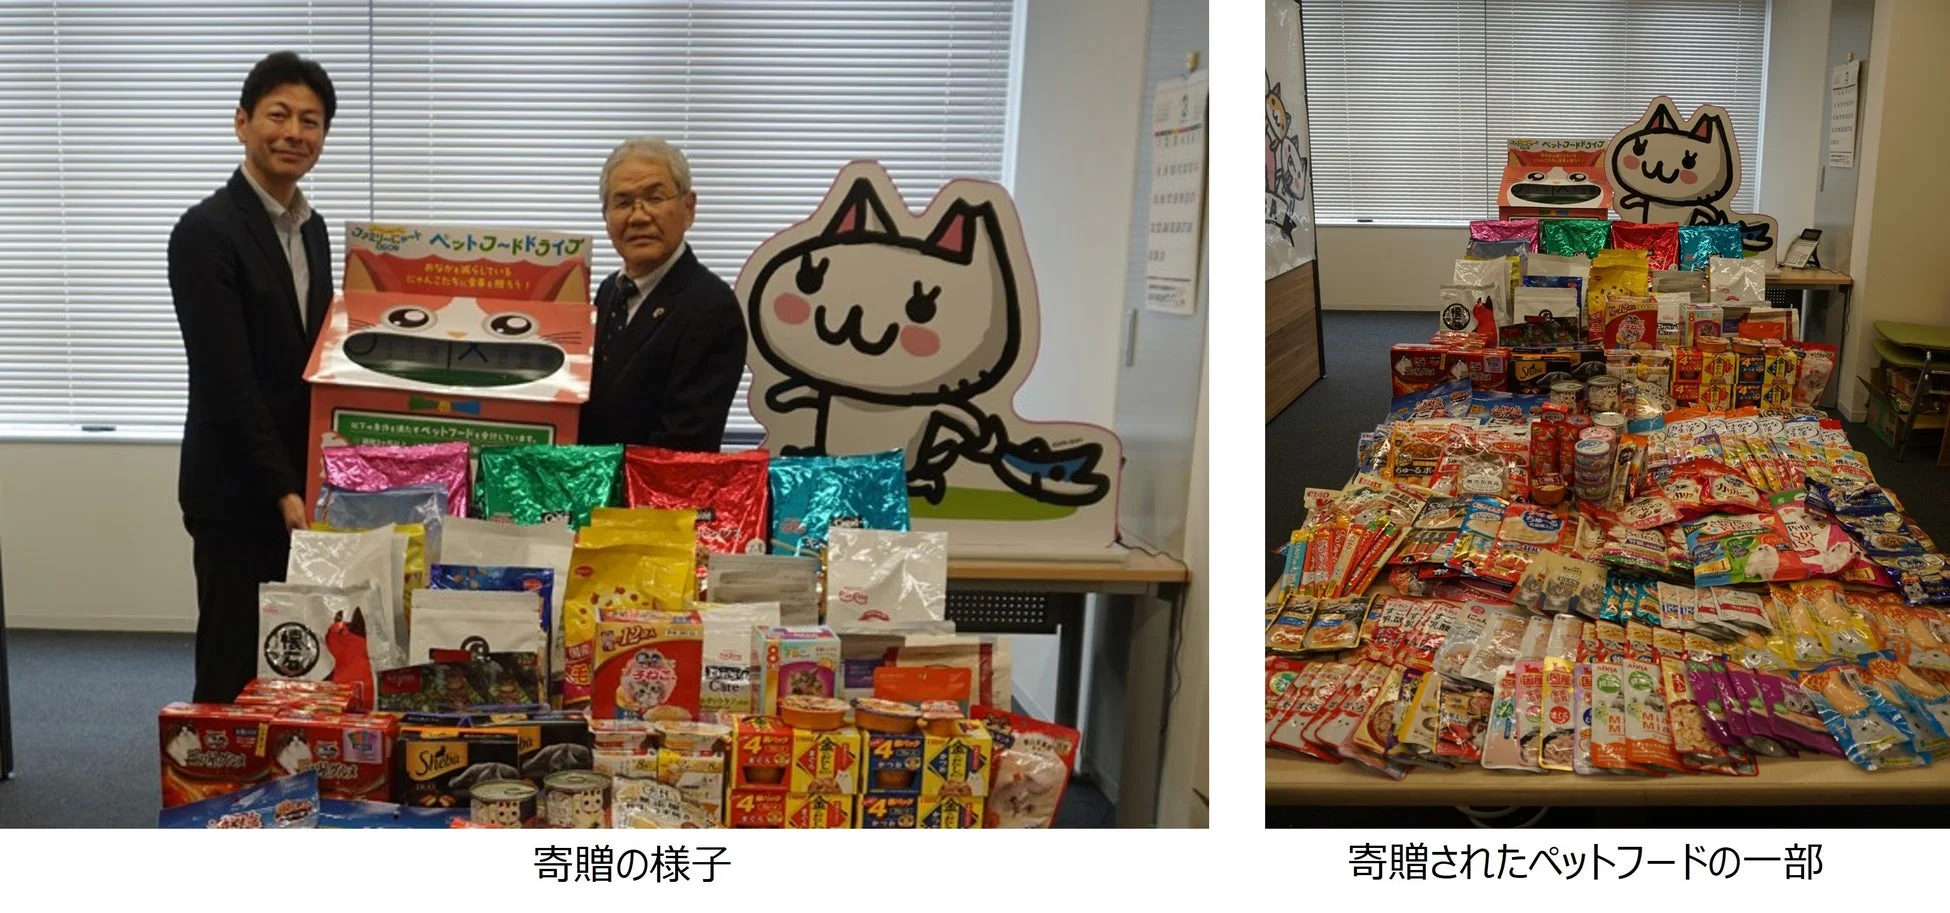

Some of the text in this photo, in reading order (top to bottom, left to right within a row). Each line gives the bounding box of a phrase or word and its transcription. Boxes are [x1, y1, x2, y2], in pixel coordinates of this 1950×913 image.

[429, 232, 585, 257] ペットフードドライブ
[415, 750, 460, 776] Sheba
